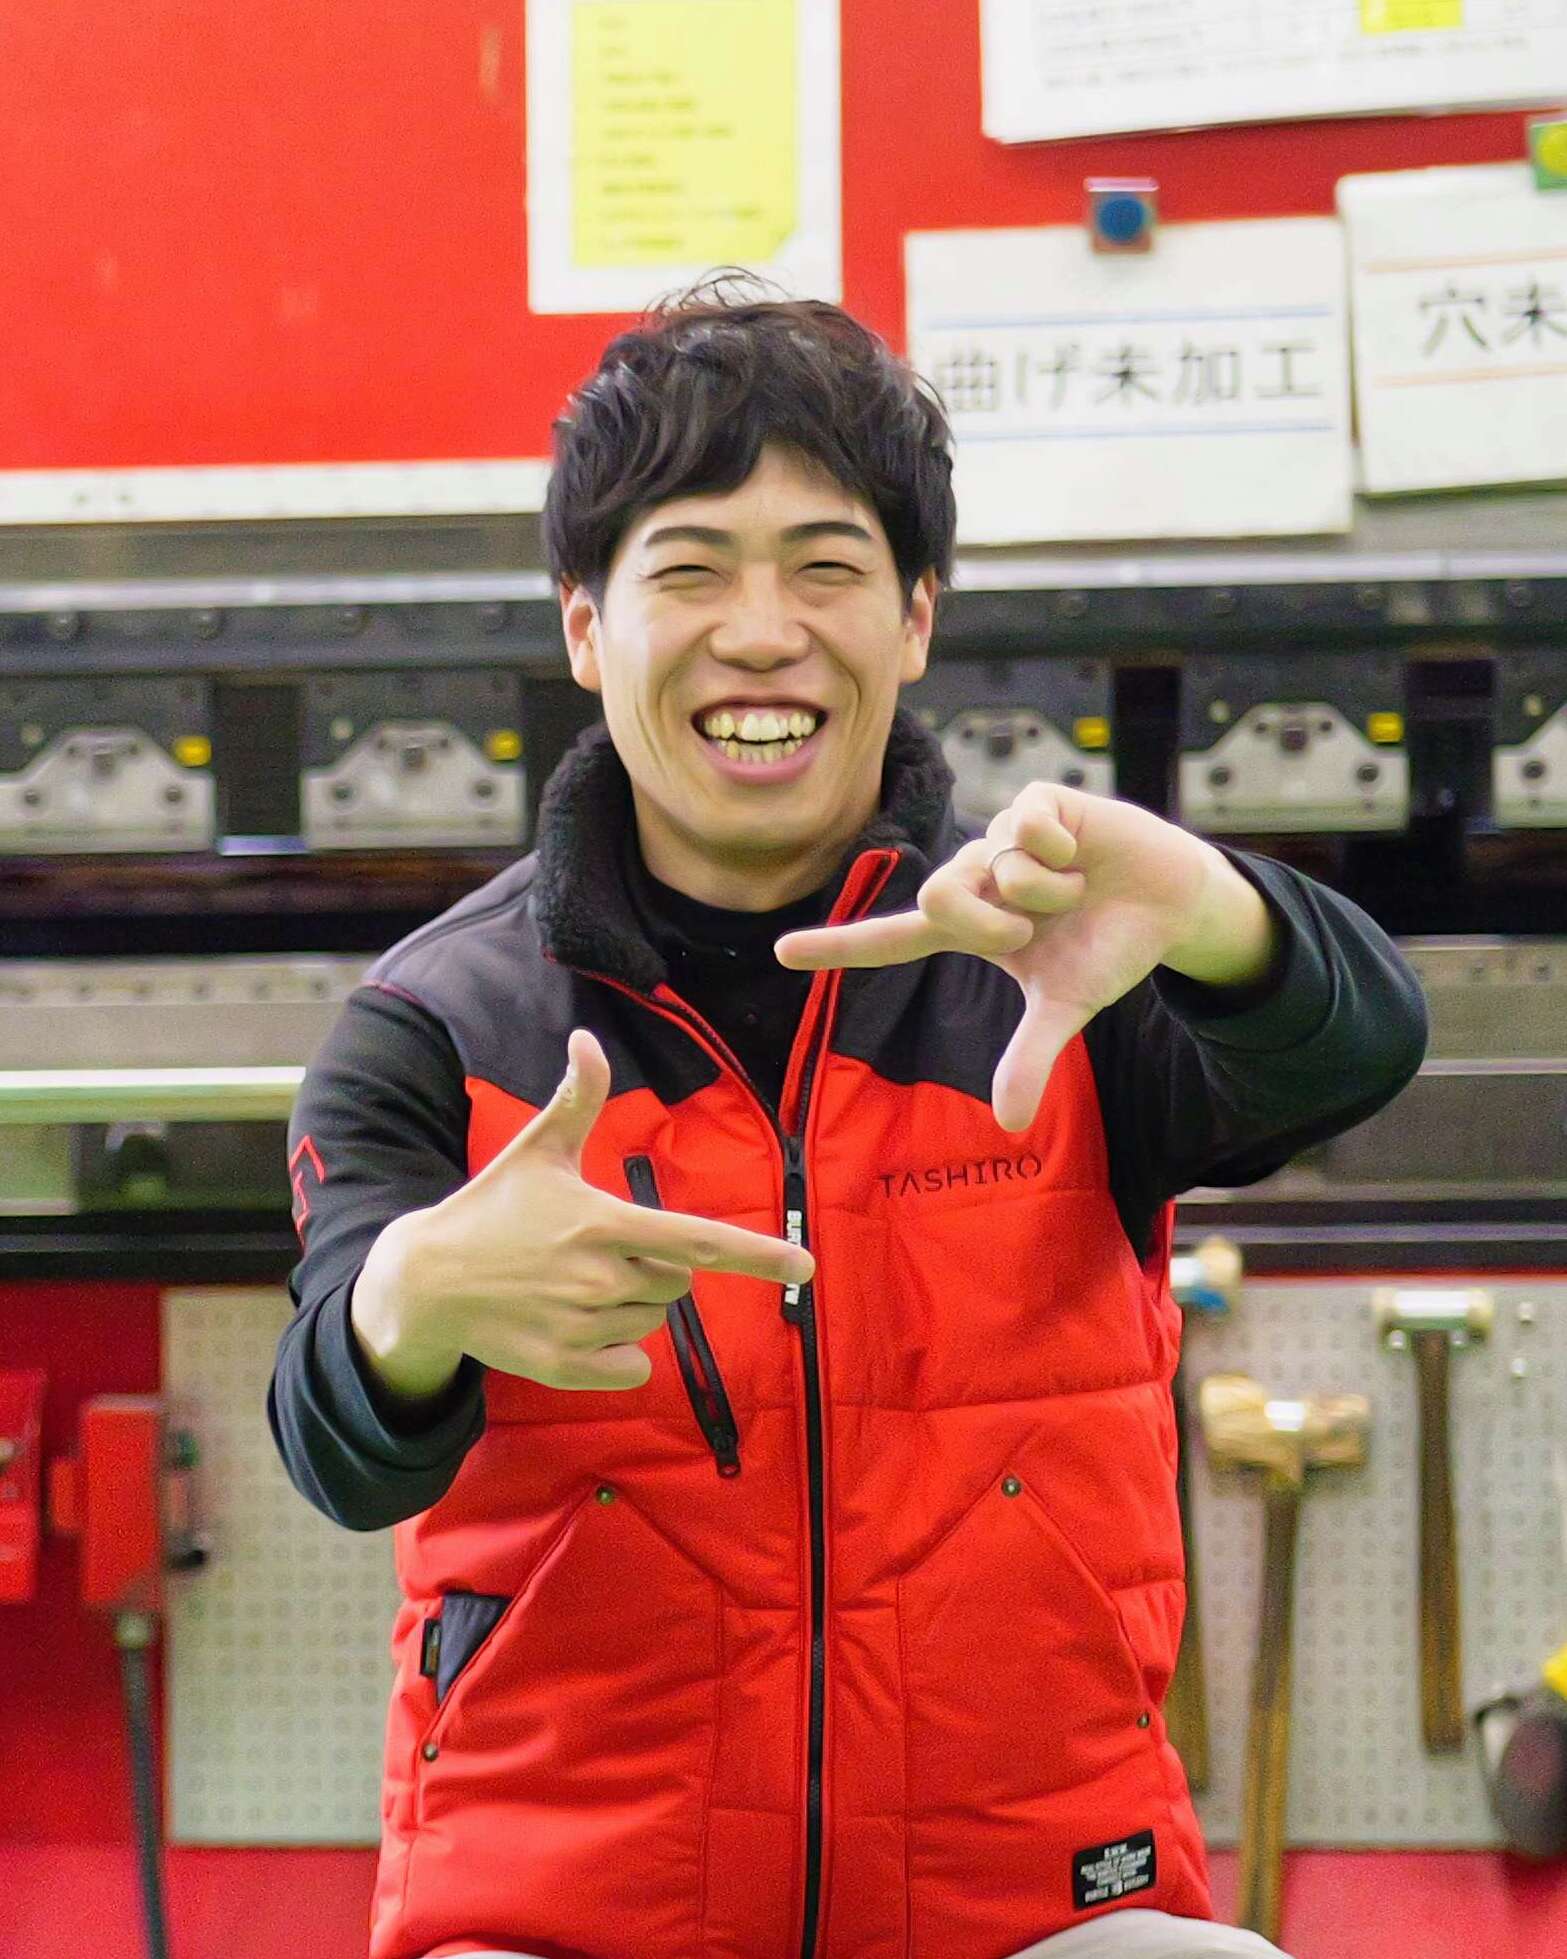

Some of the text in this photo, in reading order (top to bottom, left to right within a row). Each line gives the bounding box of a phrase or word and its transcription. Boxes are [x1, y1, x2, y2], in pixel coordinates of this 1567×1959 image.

[936, 336, 1322, 412] 曲げ未加工
[879, 1152, 1042, 1199] TASHIRO
